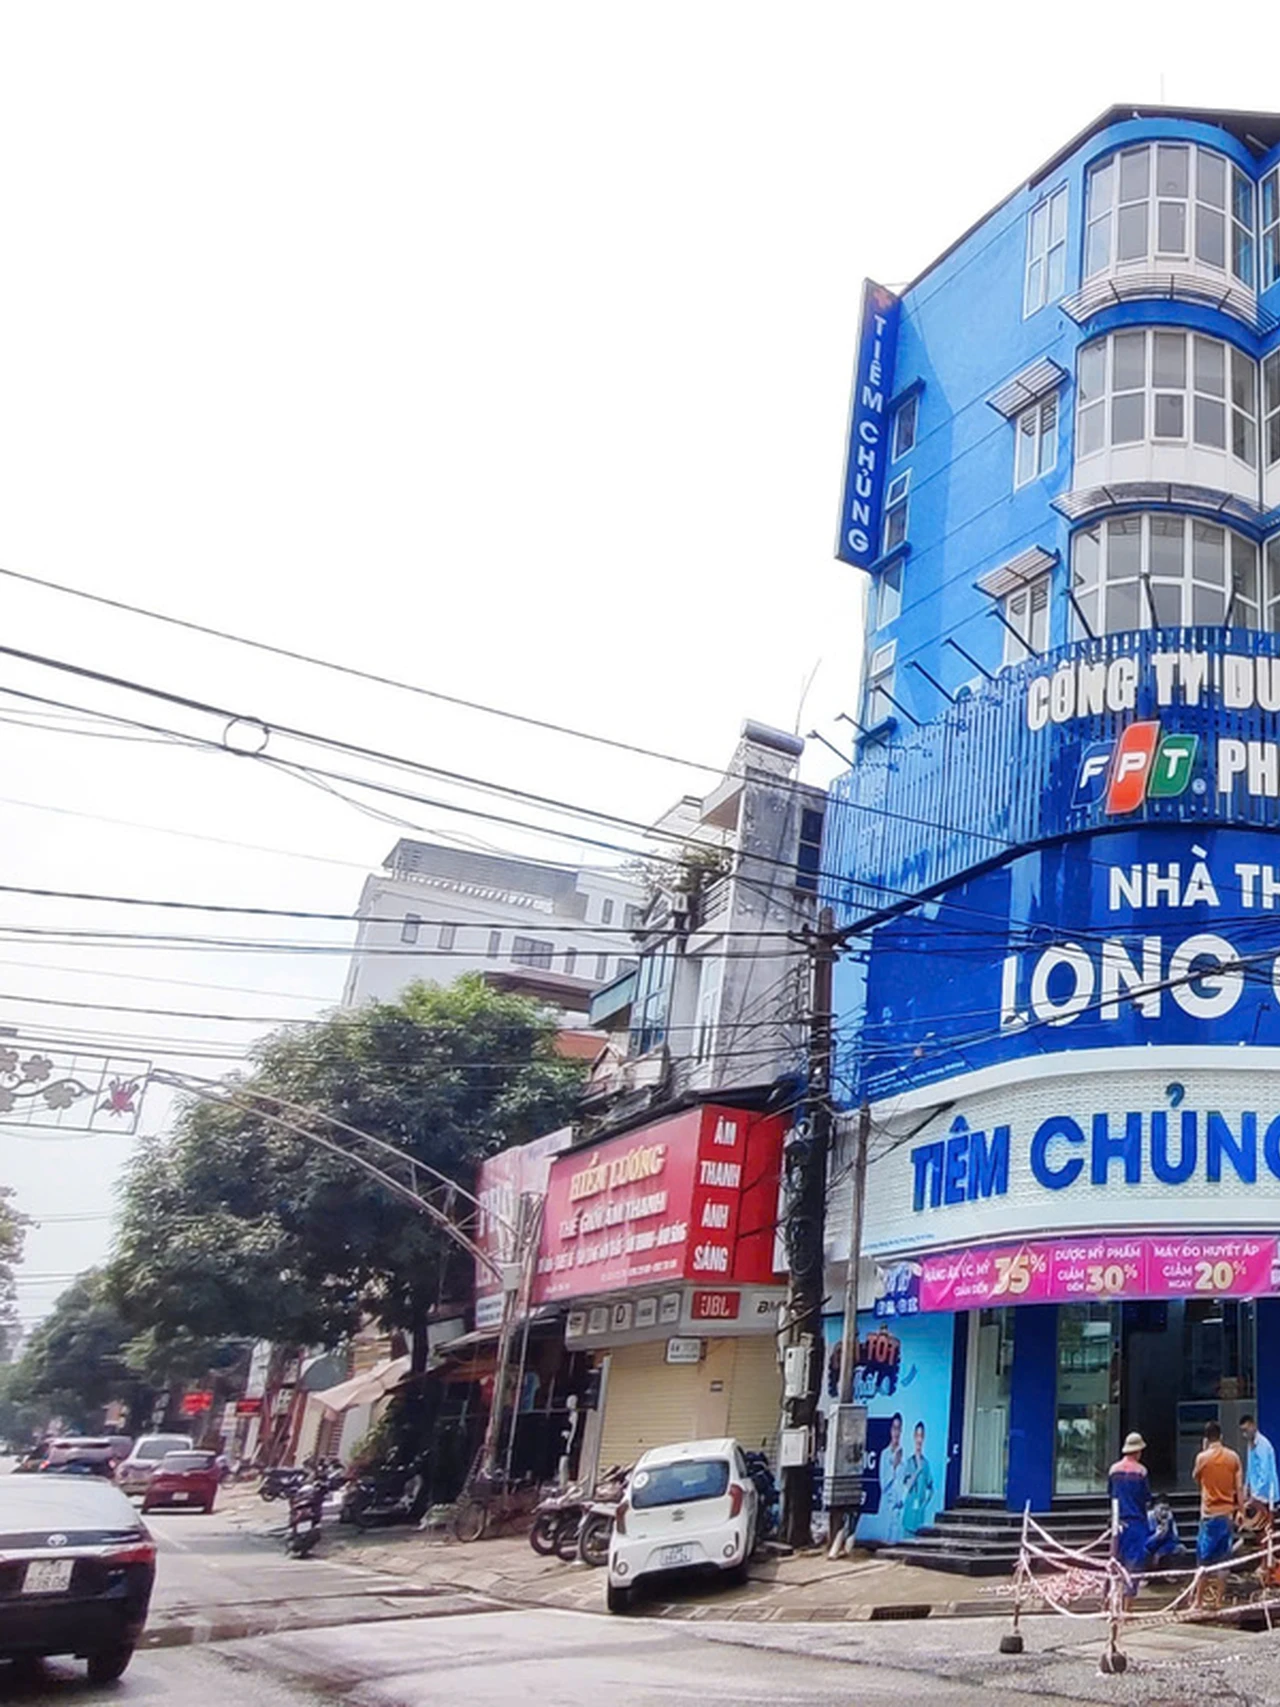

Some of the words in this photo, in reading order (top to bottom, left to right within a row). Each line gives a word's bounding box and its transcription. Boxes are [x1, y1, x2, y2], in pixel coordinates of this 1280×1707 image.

[863, 314, 887, 414] TIÊM
[1027, 658, 1136, 731] CÔNG
[1151, 653, 1203, 706] TY
[1109, 845, 1220, 911] NHÀ
[1001, 933, 1245, 1029] LONG
[700, 1160, 742, 1188] THANH
[911, 1115, 1010, 1212] TIÊM
[692, 1240, 728, 1273] SÁNG
[1086, 1264, 1138, 1293] 30%
[1194, 1260, 1247, 1291] 20%
[701, 1295, 730, 1317] JBL
